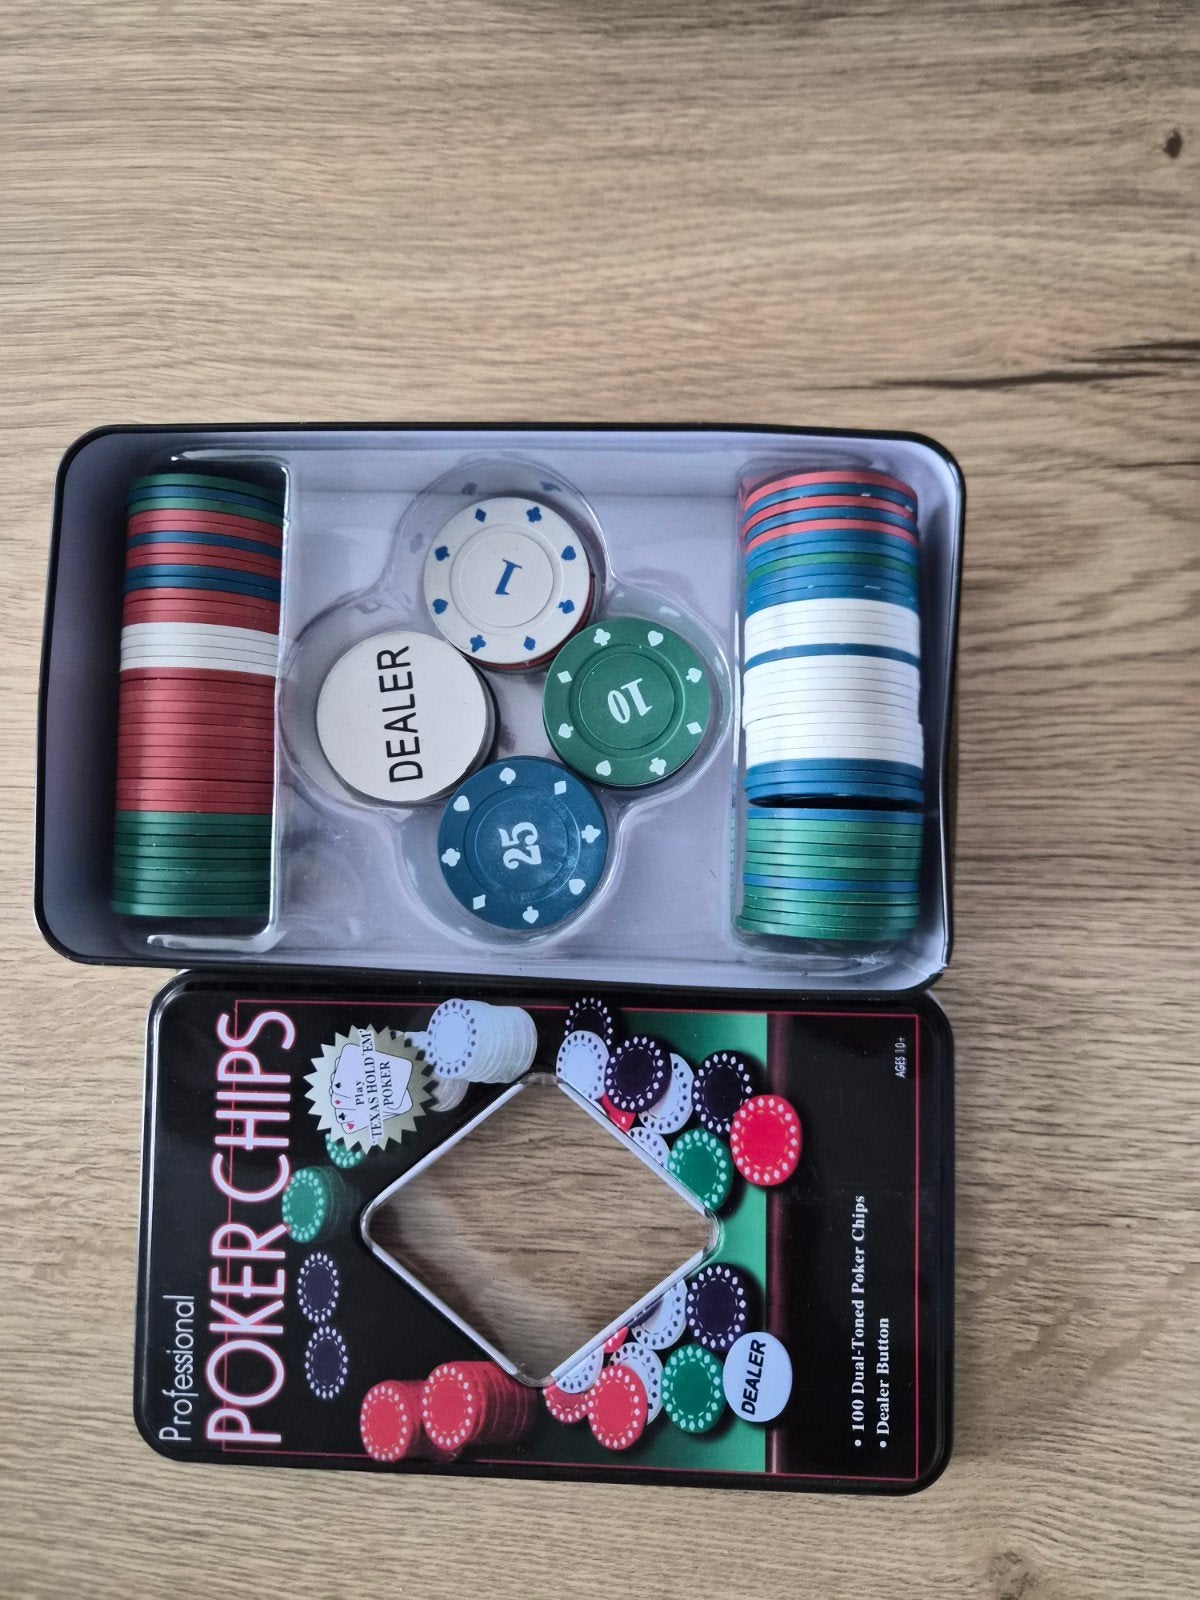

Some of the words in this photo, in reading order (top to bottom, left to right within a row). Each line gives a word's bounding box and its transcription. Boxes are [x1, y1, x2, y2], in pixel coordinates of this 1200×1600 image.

[377, 645, 423, 783] DEALER
[607, 677, 653, 725] 10
[500, 820, 542, 870] 25
[895, 1036, 906, 1053] 10+
[895, 1056, 906, 1078] AGES
[355, 1080, 365, 1105] Play
[364, 1058, 378, 1094] HOLD
[380, 1061, 394, 1106] POKER
[211, 1010, 296, 1202] CHIPS
[852, 1195, 868, 1241] Chips
[851, 1246, 865, 1293] Poker
[205, 1223, 287, 1443] POKER
[851, 1300, 865, 1394] Dual-Toned
[876, 1317, 890, 1375] Button
[159, 1295, 198, 1441] Professional
[741, 1338, 767, 1415] DEALER
[851, 1399, 865, 1431] 100
[877, 1379, 890, 1435] Dealer
